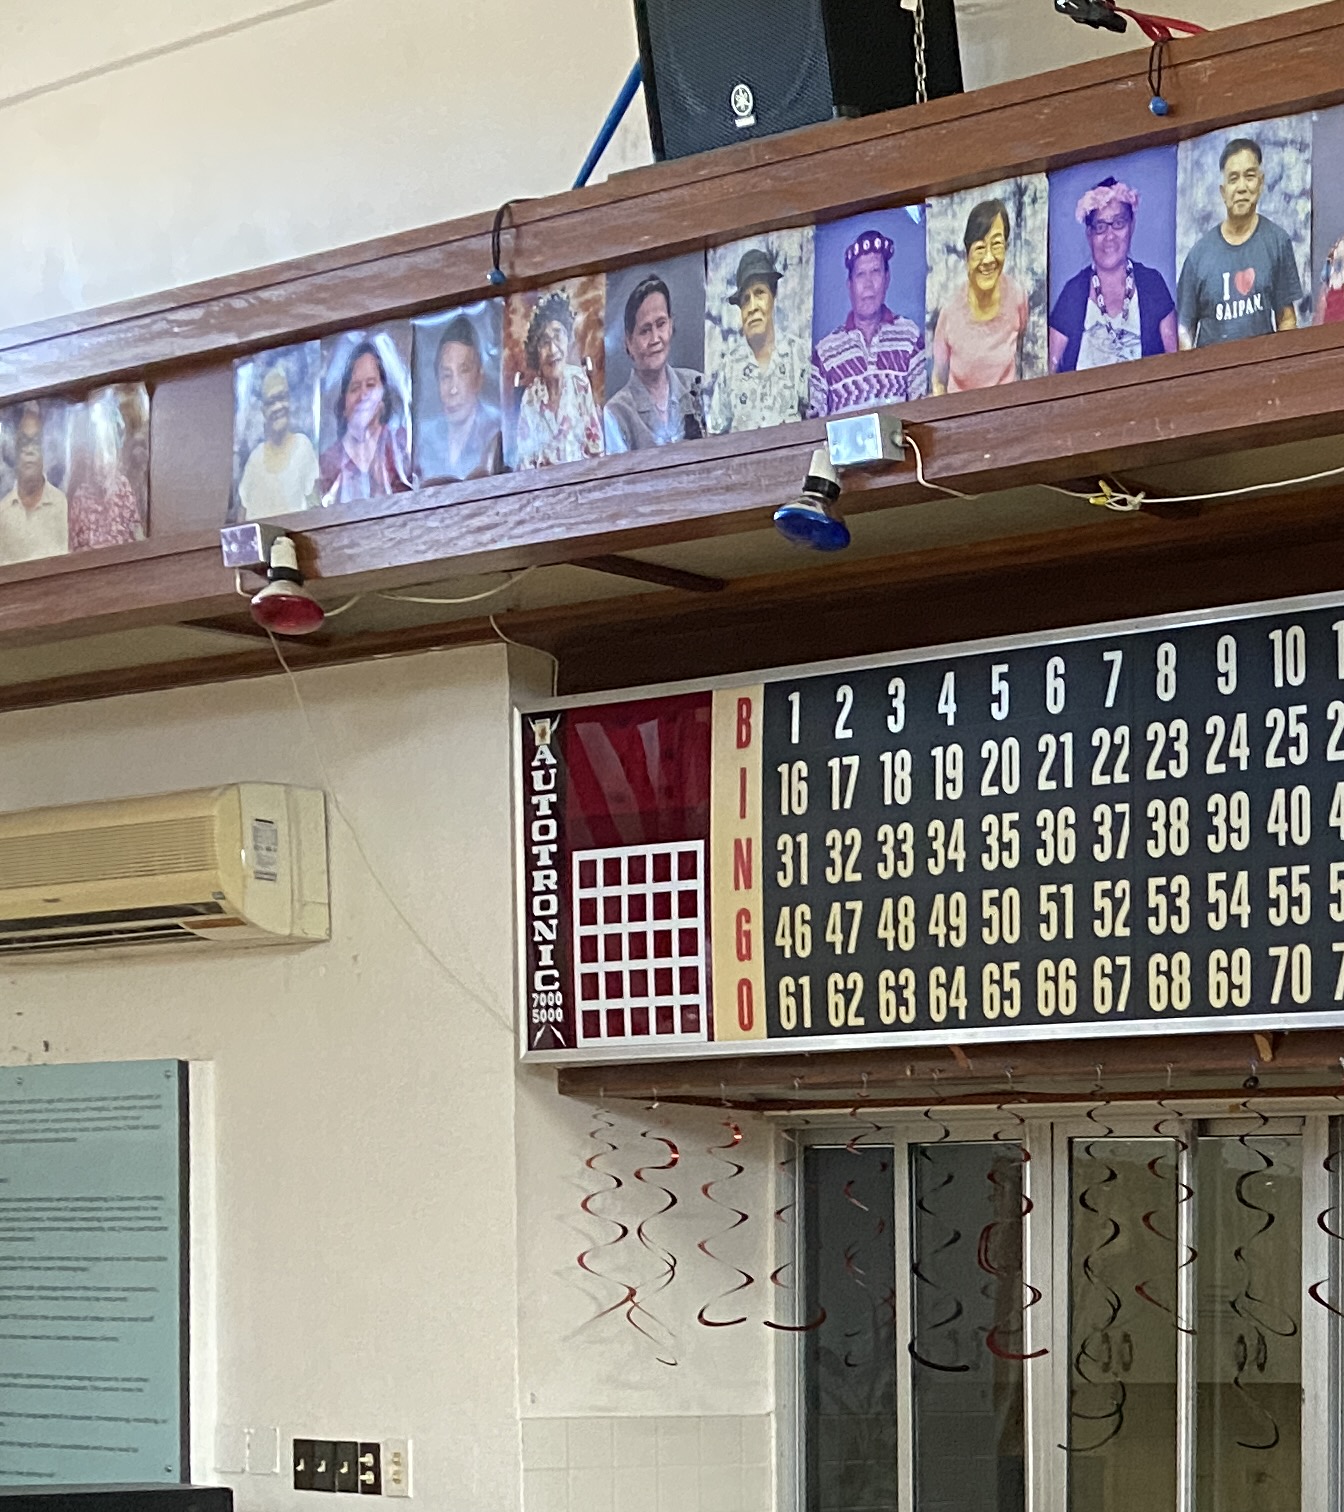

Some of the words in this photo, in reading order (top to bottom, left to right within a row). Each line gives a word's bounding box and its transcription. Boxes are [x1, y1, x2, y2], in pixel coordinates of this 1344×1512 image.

[1222, 271, 1231, 301] I
[787, 691, 801, 744] 1
[834, 684, 854, 740] 2
[886, 677, 906, 734] 3
[937, 671, 957, 727] 4
[990, 663, 1010, 721] 5
[1045, 656, 1066, 715] 6
[1102, 650, 1123, 708] 7
[1156, 642, 1177, 702] 8
[1216, 634, 1237, 695] 9
[1268, 625, 1306, 688] 10
[777, 760, 809, 816] 16
[827, 754, 860, 811] 17
[879, 748, 912, 806] 18
[930, 743, 964, 801] 19
[980, 736, 1021, 797] 20
[1037, 731, 1074, 791] 21
[1091, 725, 1130, 786] 22
[1145, 718, 1189, 781] 23
[1205, 712, 1250, 775] 24
[1265, 704, 1309, 769] 25
[531, 744, 559, 991] AUTOTRONIC
[776, 832, 809, 888] 31
[825, 827, 863, 884] 32
[876, 821, 915, 880] 33
[927, 818, 967, 876] 34
[981, 811, 1020, 872] 35
[1035, 806, 1077, 867] 36
[1092, 802, 1130, 863] 37
[1146, 796, 1190, 859] 38
[1206, 790, 1250, 854] 39
[1266, 784, 1311, 847] 40
[774, 903, 812, 959] 46
[825, 900, 863, 955] 47
[877, 895, 916, 952] 48
[928, 891, 967, 948] 49
[981, 886, 1021, 946] 50
[1039, 883, 1074, 942] 51
[1093, 879, 1131, 938] 52
[1147, 874, 1191, 936] 53
[1207, 870, 1252, 931] 54
[1268, 864, 1311, 927] 55
[532, 991, 563, 1008] 7000
[532, 1007, 563, 1024] 5000
[778, 975, 812, 1031] 61
[827, 971, 865, 1028] 62
[878, 967, 917, 1025] 63
[928, 965, 968, 1023] 64
[982, 961, 1022, 1020] 65
[1036, 957, 1077, 1017] 66
[1093, 955, 1131, 1015] 67
[1148, 951, 1192, 1012] 68
[1208, 947, 1252, 1009] 69
[1268, 943, 1312, 1005] 70
